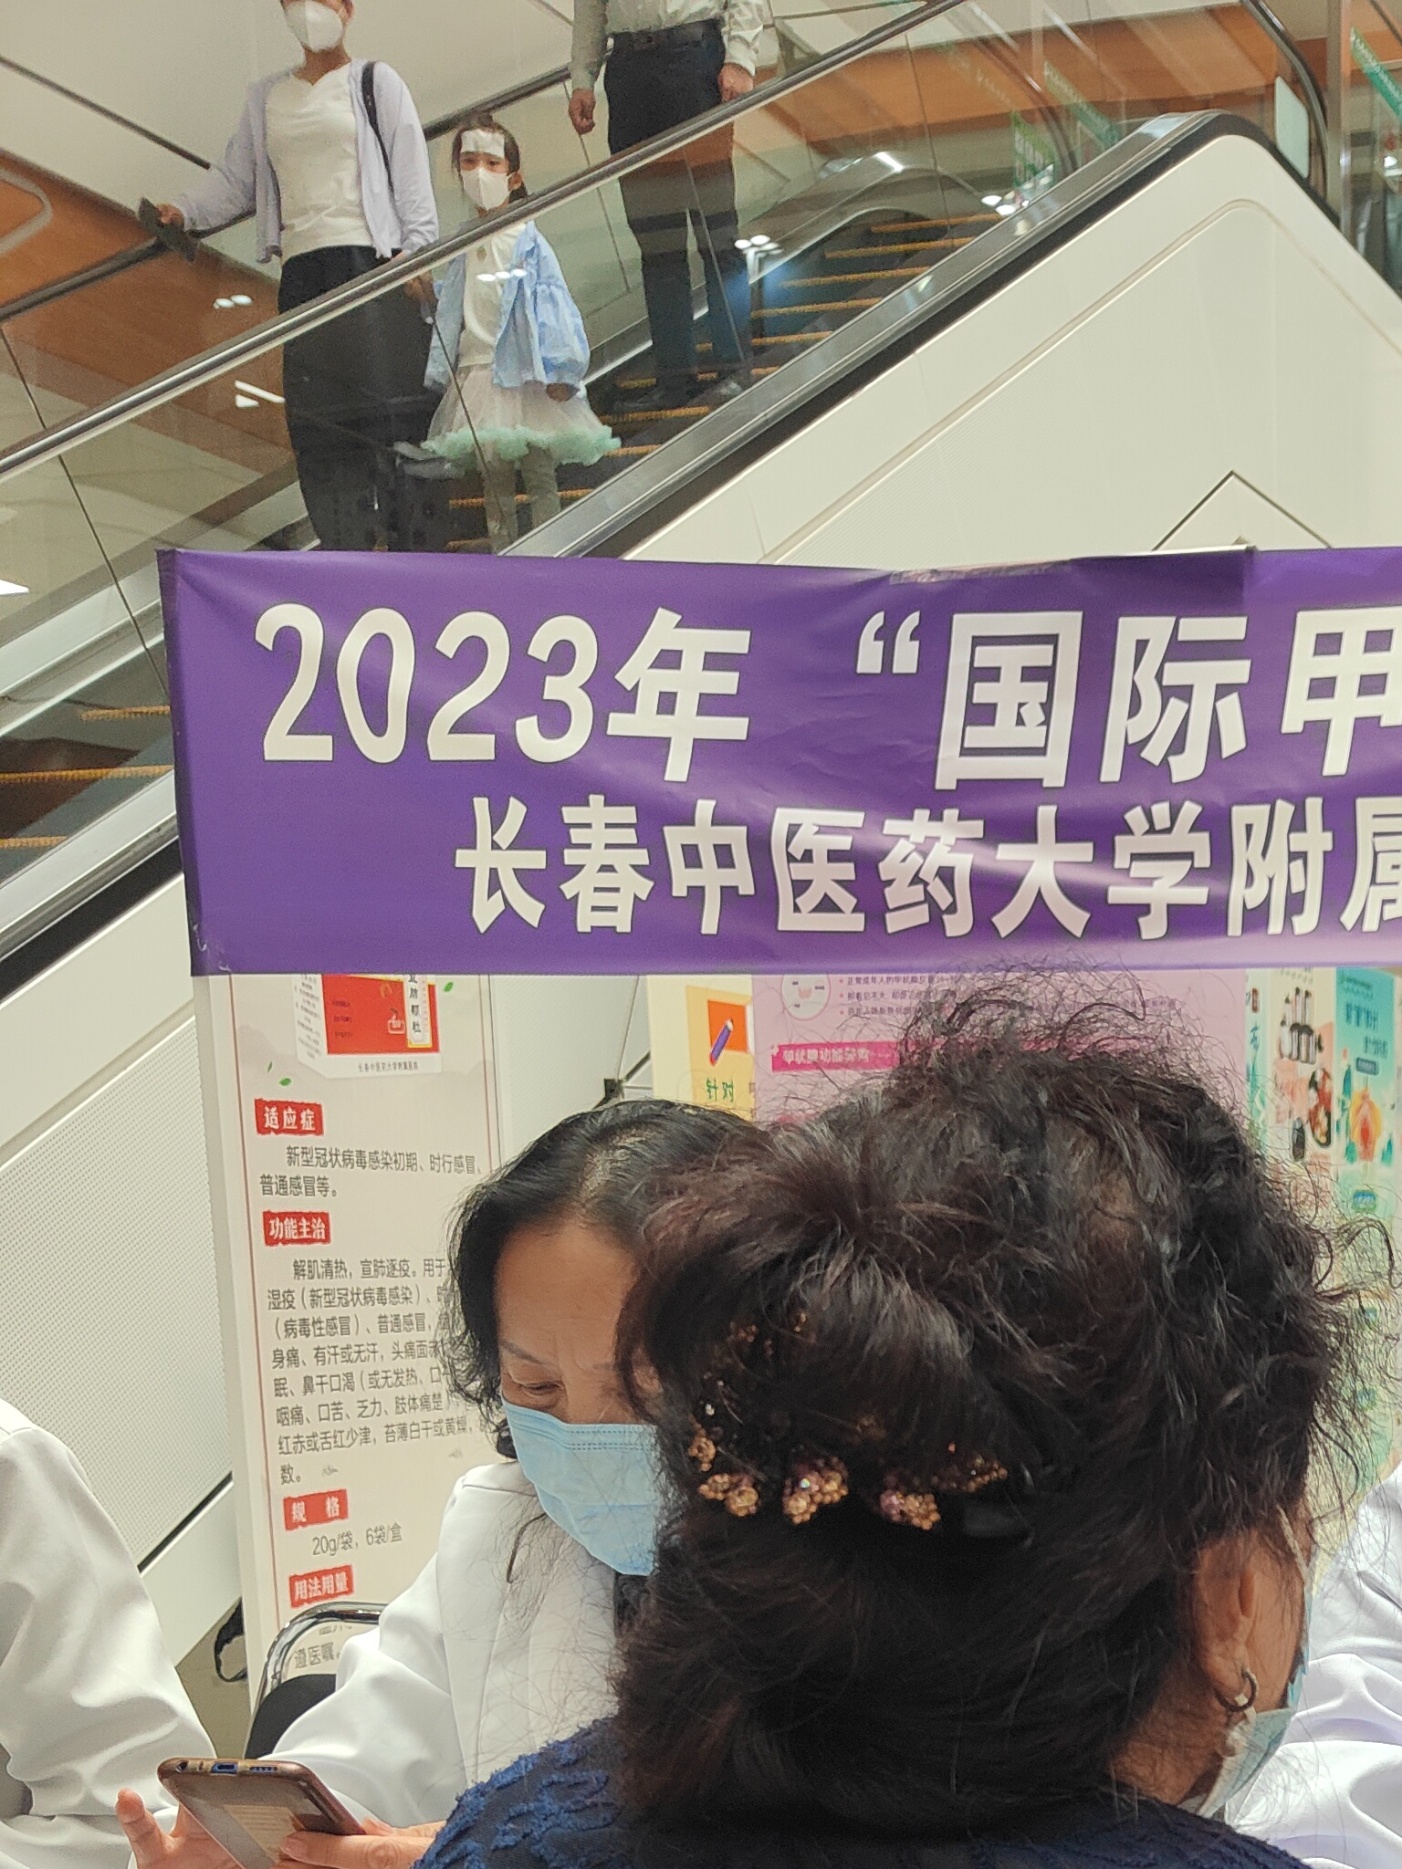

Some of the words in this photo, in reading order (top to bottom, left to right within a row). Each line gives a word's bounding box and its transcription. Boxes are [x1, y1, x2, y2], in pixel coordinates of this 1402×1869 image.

[254, 602, 752, 784] 2023年
[264, 1105, 316, 1131] 适应症
[286, 1145, 482, 1176] 新型冠状病毒感染初期、时行感冒、
[260, 1173, 337, 1198] 普通感冒等。
[269, 1217, 326, 1240] 功能主治
[280, 1464, 301, 1485] 数。
[294, 1571, 350, 1602] 用法用量
